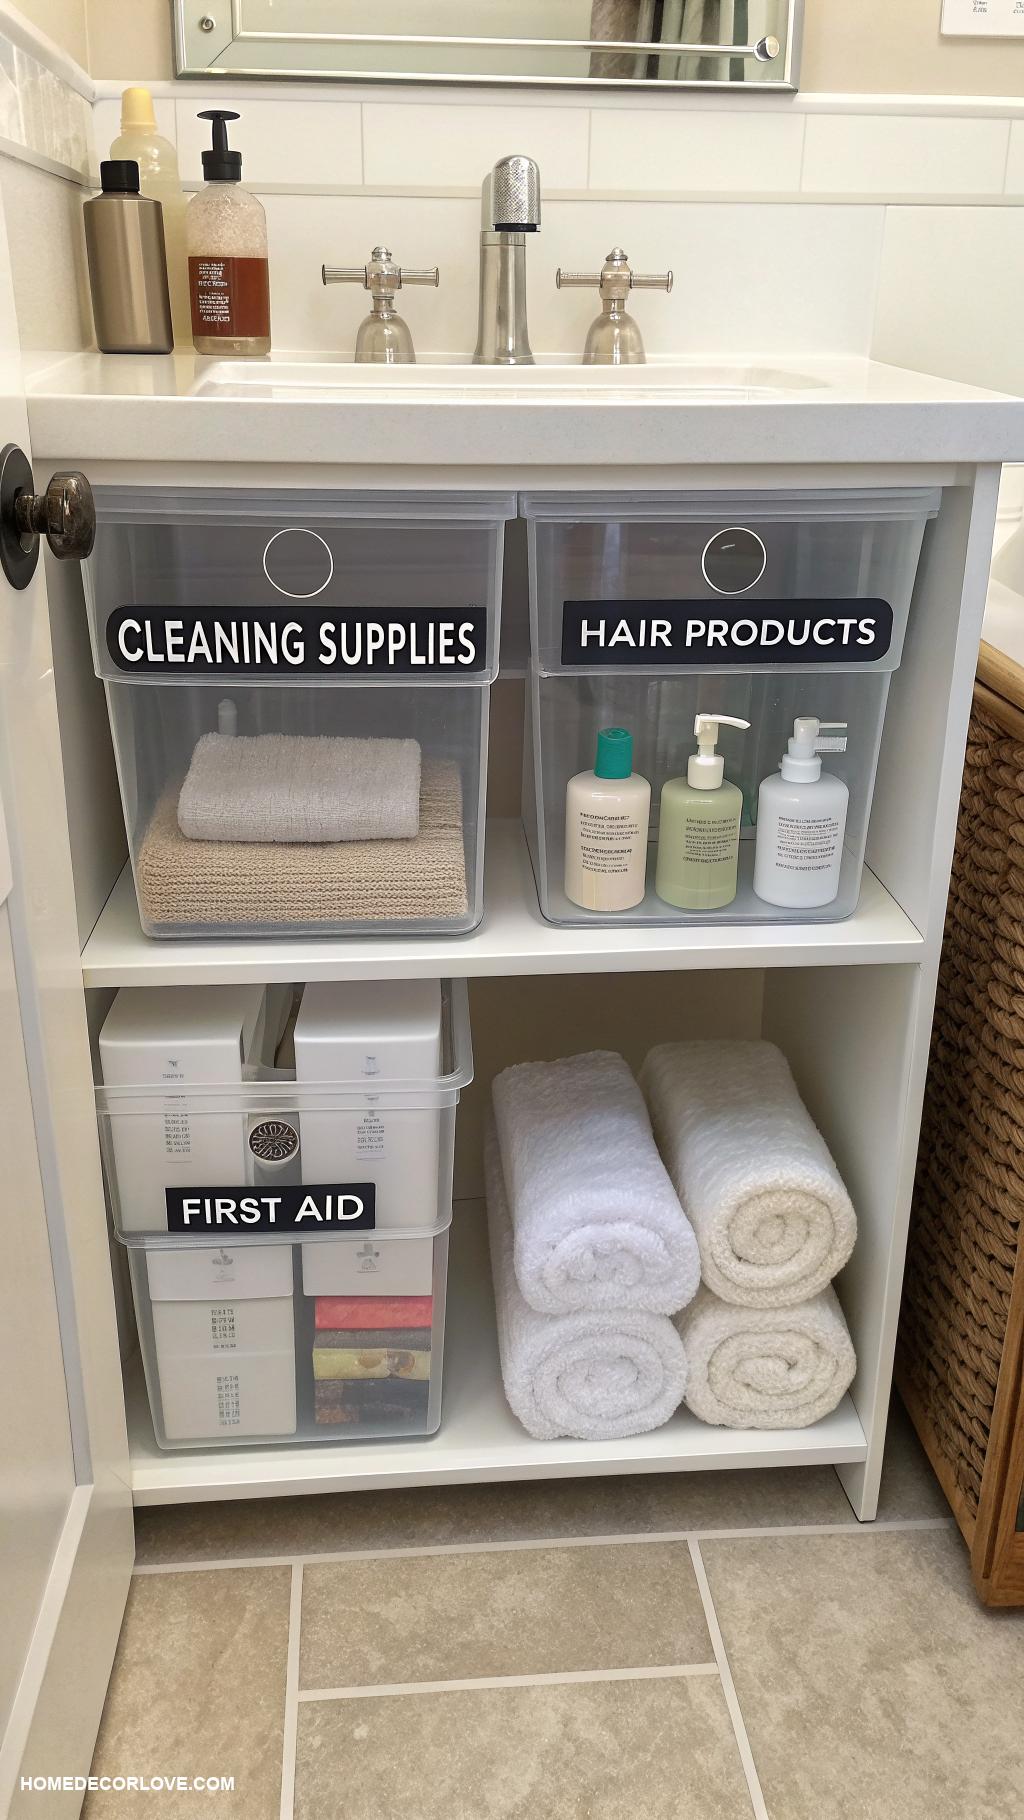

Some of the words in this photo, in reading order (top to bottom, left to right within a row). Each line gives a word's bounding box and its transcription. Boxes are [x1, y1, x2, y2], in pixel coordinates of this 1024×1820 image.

[118, 618, 304, 664] CLEANING
[319, 621, 476, 665] SUPPLIES
[580, 619, 673, 647] HAIR
[685, 618, 876, 647] PRODUCTS
[182, 1197, 282, 1224] FIRST
[294, 1195, 364, 1222] AID
